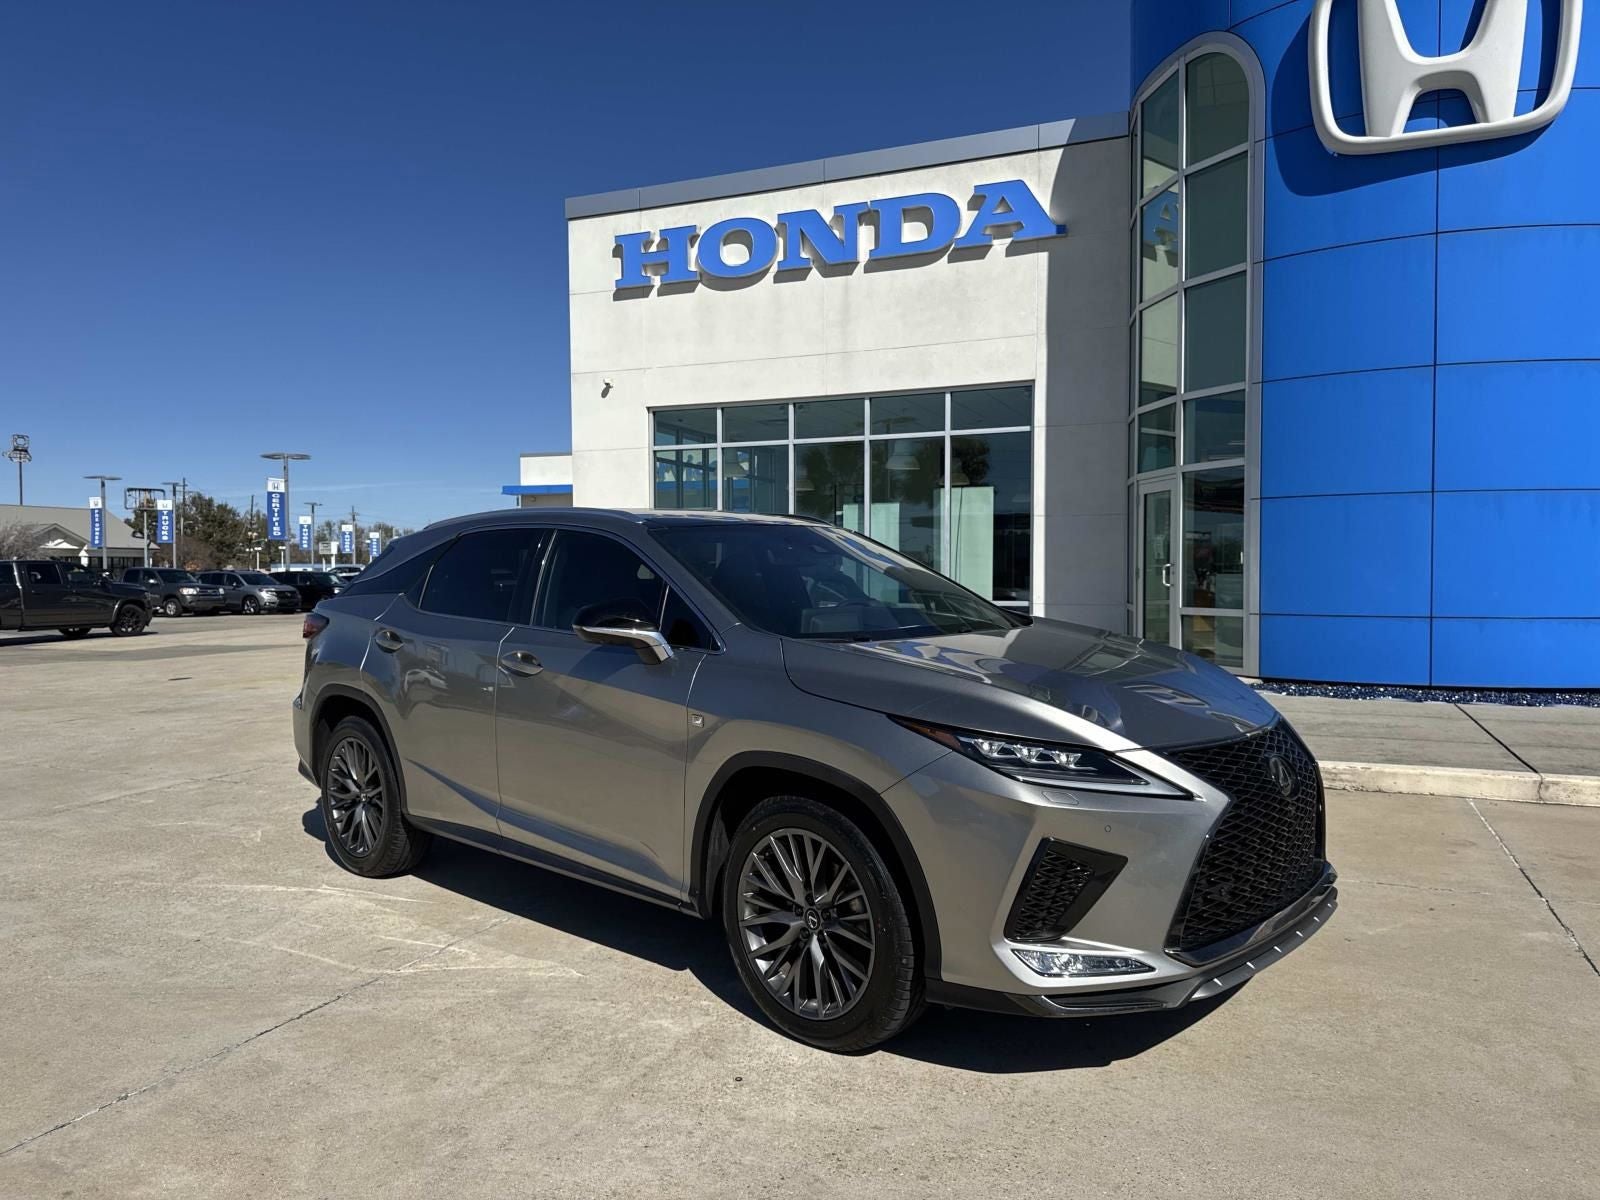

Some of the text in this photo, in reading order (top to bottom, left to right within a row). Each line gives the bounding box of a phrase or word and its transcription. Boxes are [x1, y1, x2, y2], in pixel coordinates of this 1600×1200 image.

[613, 179, 1064, 289] HONDA
[161, 510, 169, 541] TRUCKS
[271, 493, 281, 536] CERTIFIED
